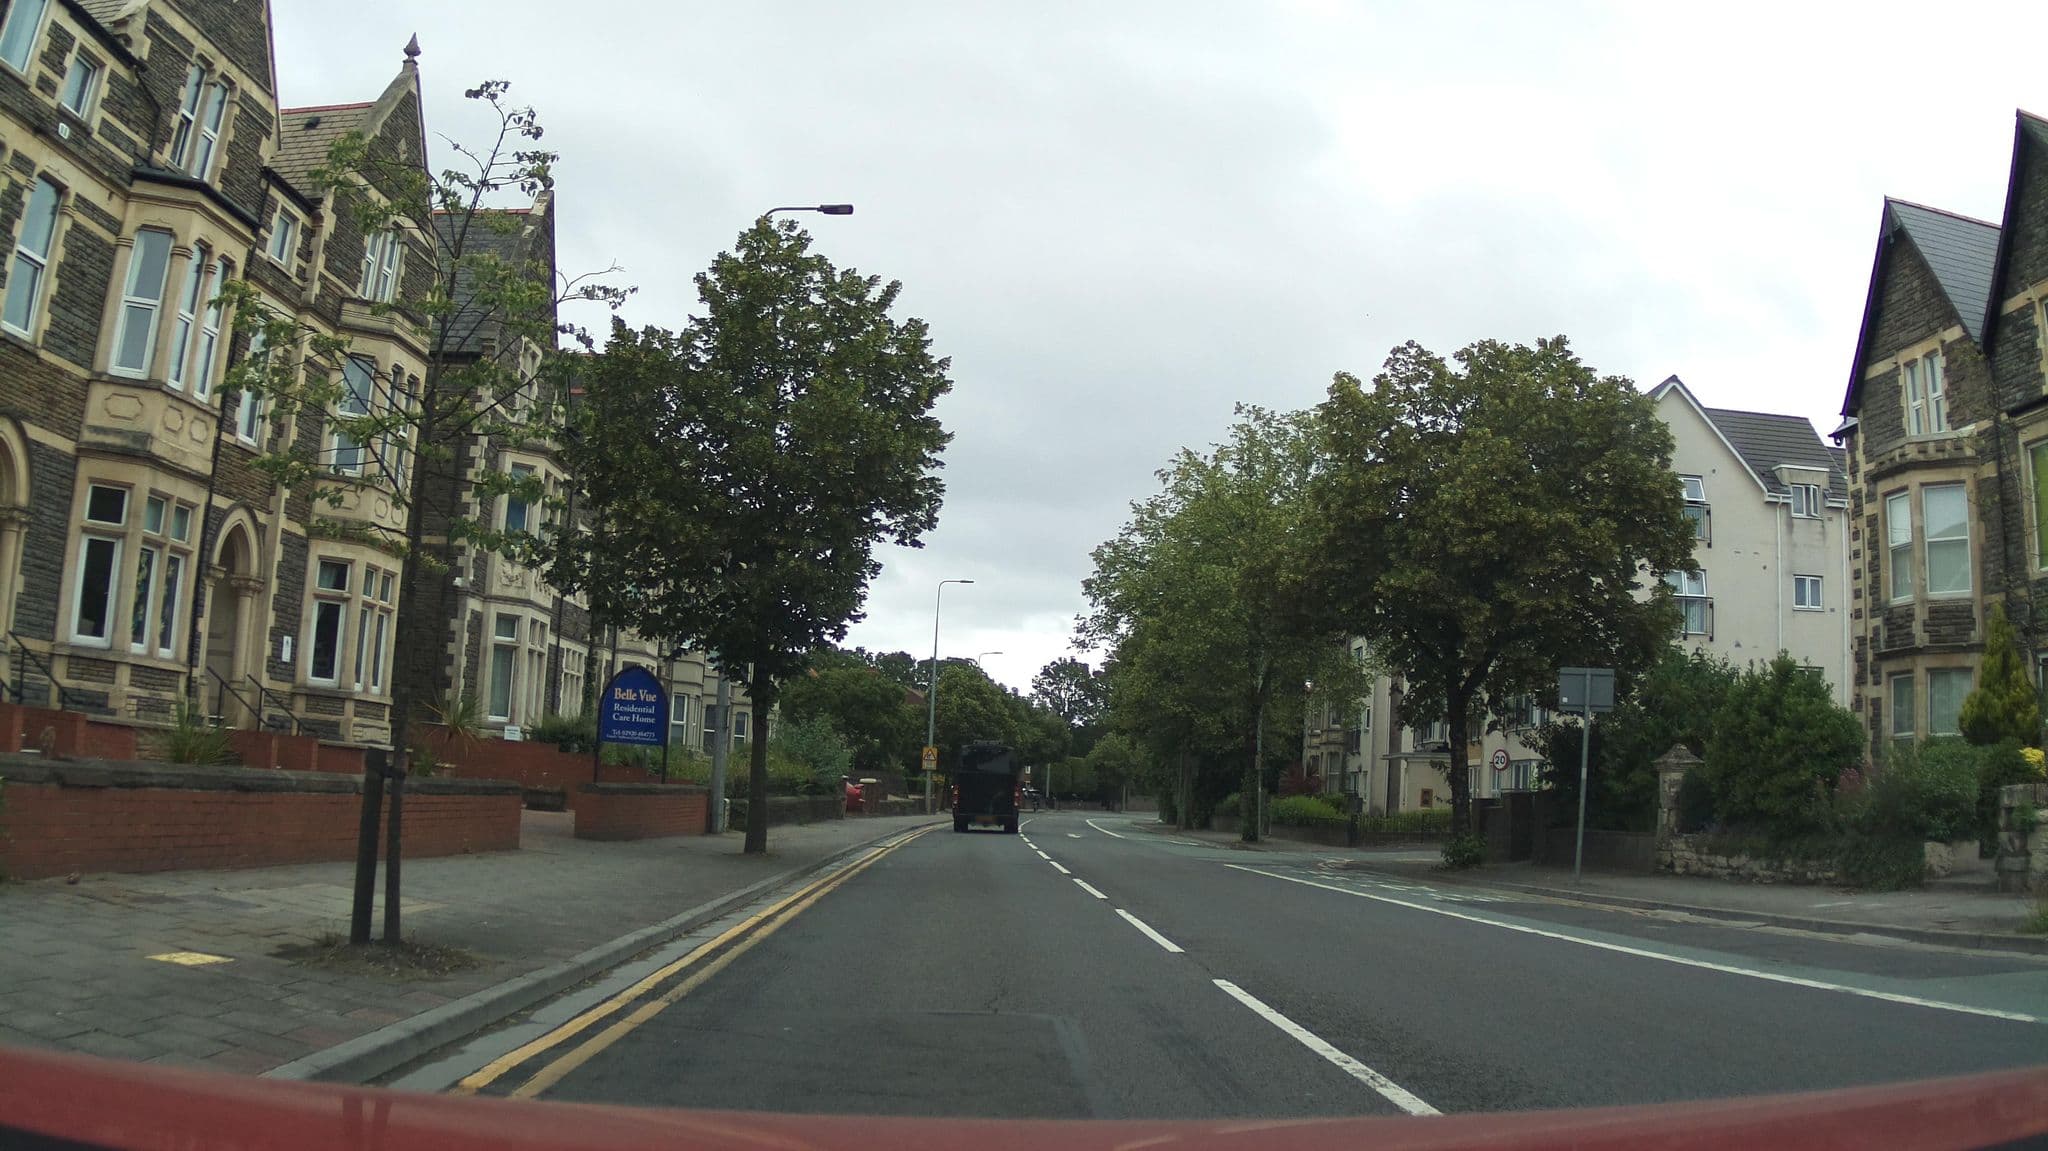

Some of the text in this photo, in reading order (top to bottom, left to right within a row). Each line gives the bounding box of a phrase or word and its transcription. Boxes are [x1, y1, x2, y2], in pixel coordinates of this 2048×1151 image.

[614, 687, 657, 702] Belle Vue
[613, 703, 655, 714] Residential
[612, 713, 656, 723] Care Home
[1495, 755, 1506, 765] 20
